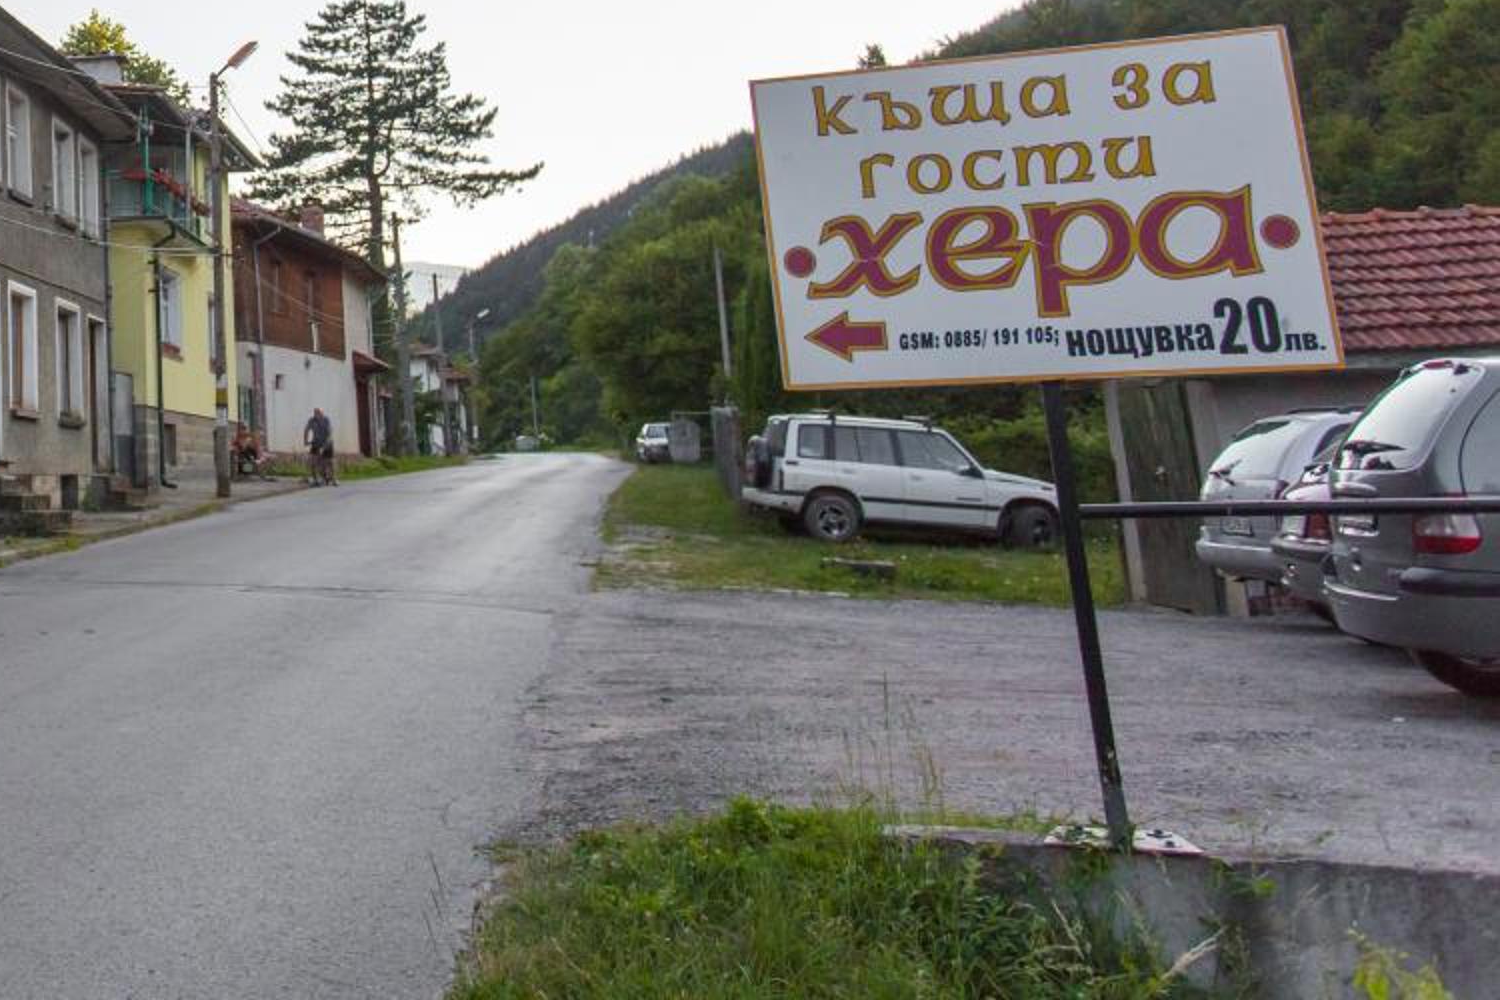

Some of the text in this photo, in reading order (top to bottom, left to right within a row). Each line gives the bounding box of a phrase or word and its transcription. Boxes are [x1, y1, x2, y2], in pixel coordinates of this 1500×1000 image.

[811, 59, 1218, 137] къща за
[858, 134, 1157, 199] гости
[806, 184, 1264, 318] хера
[899, 331, 940, 350] GSM:
[943, 328, 988, 348] 0885/
[992, 327, 1020, 346] 191
[1212, 296, 1283, 355] 20
[1284, 333, 1328, 352] лв.
